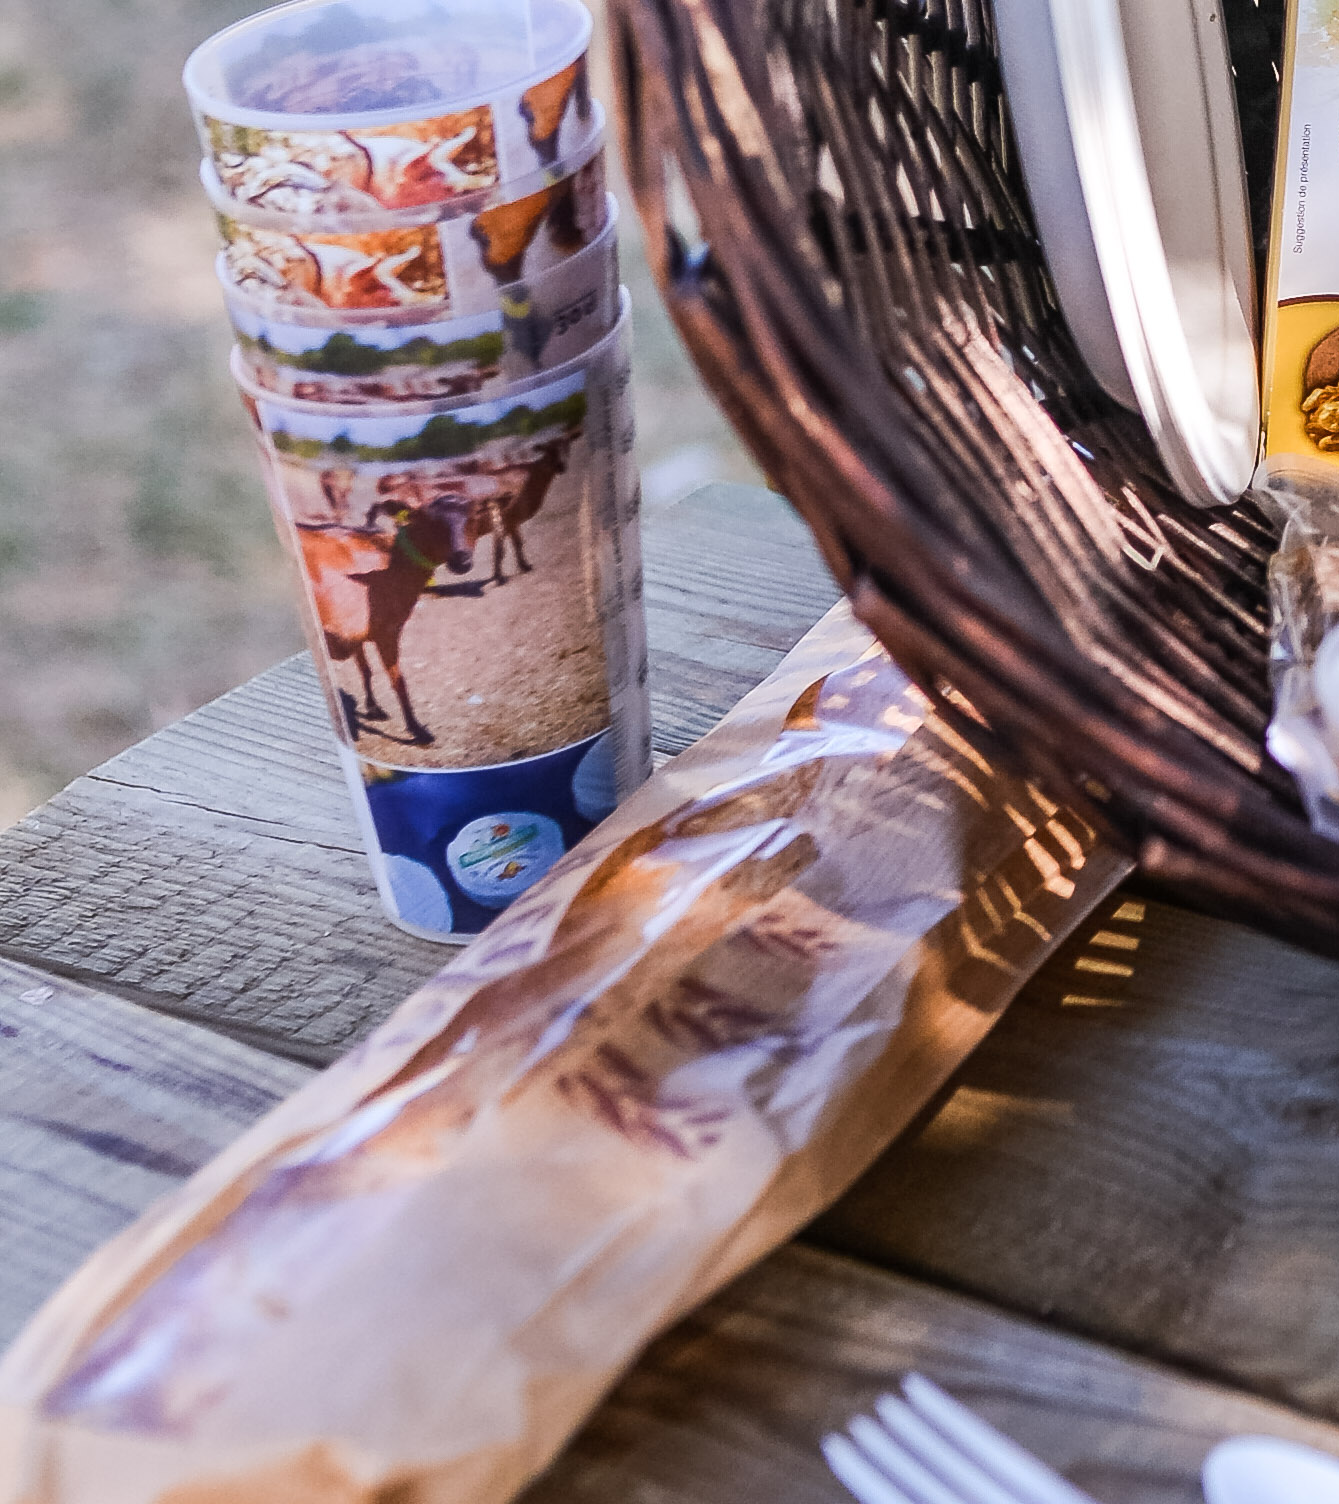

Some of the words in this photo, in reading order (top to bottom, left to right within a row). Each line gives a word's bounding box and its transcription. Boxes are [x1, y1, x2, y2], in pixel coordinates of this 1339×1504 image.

[1300, 123, 1312, 183] présentation
[1298, 185, 1307, 198] de
[1293, 200, 1306, 254] Suggestion
